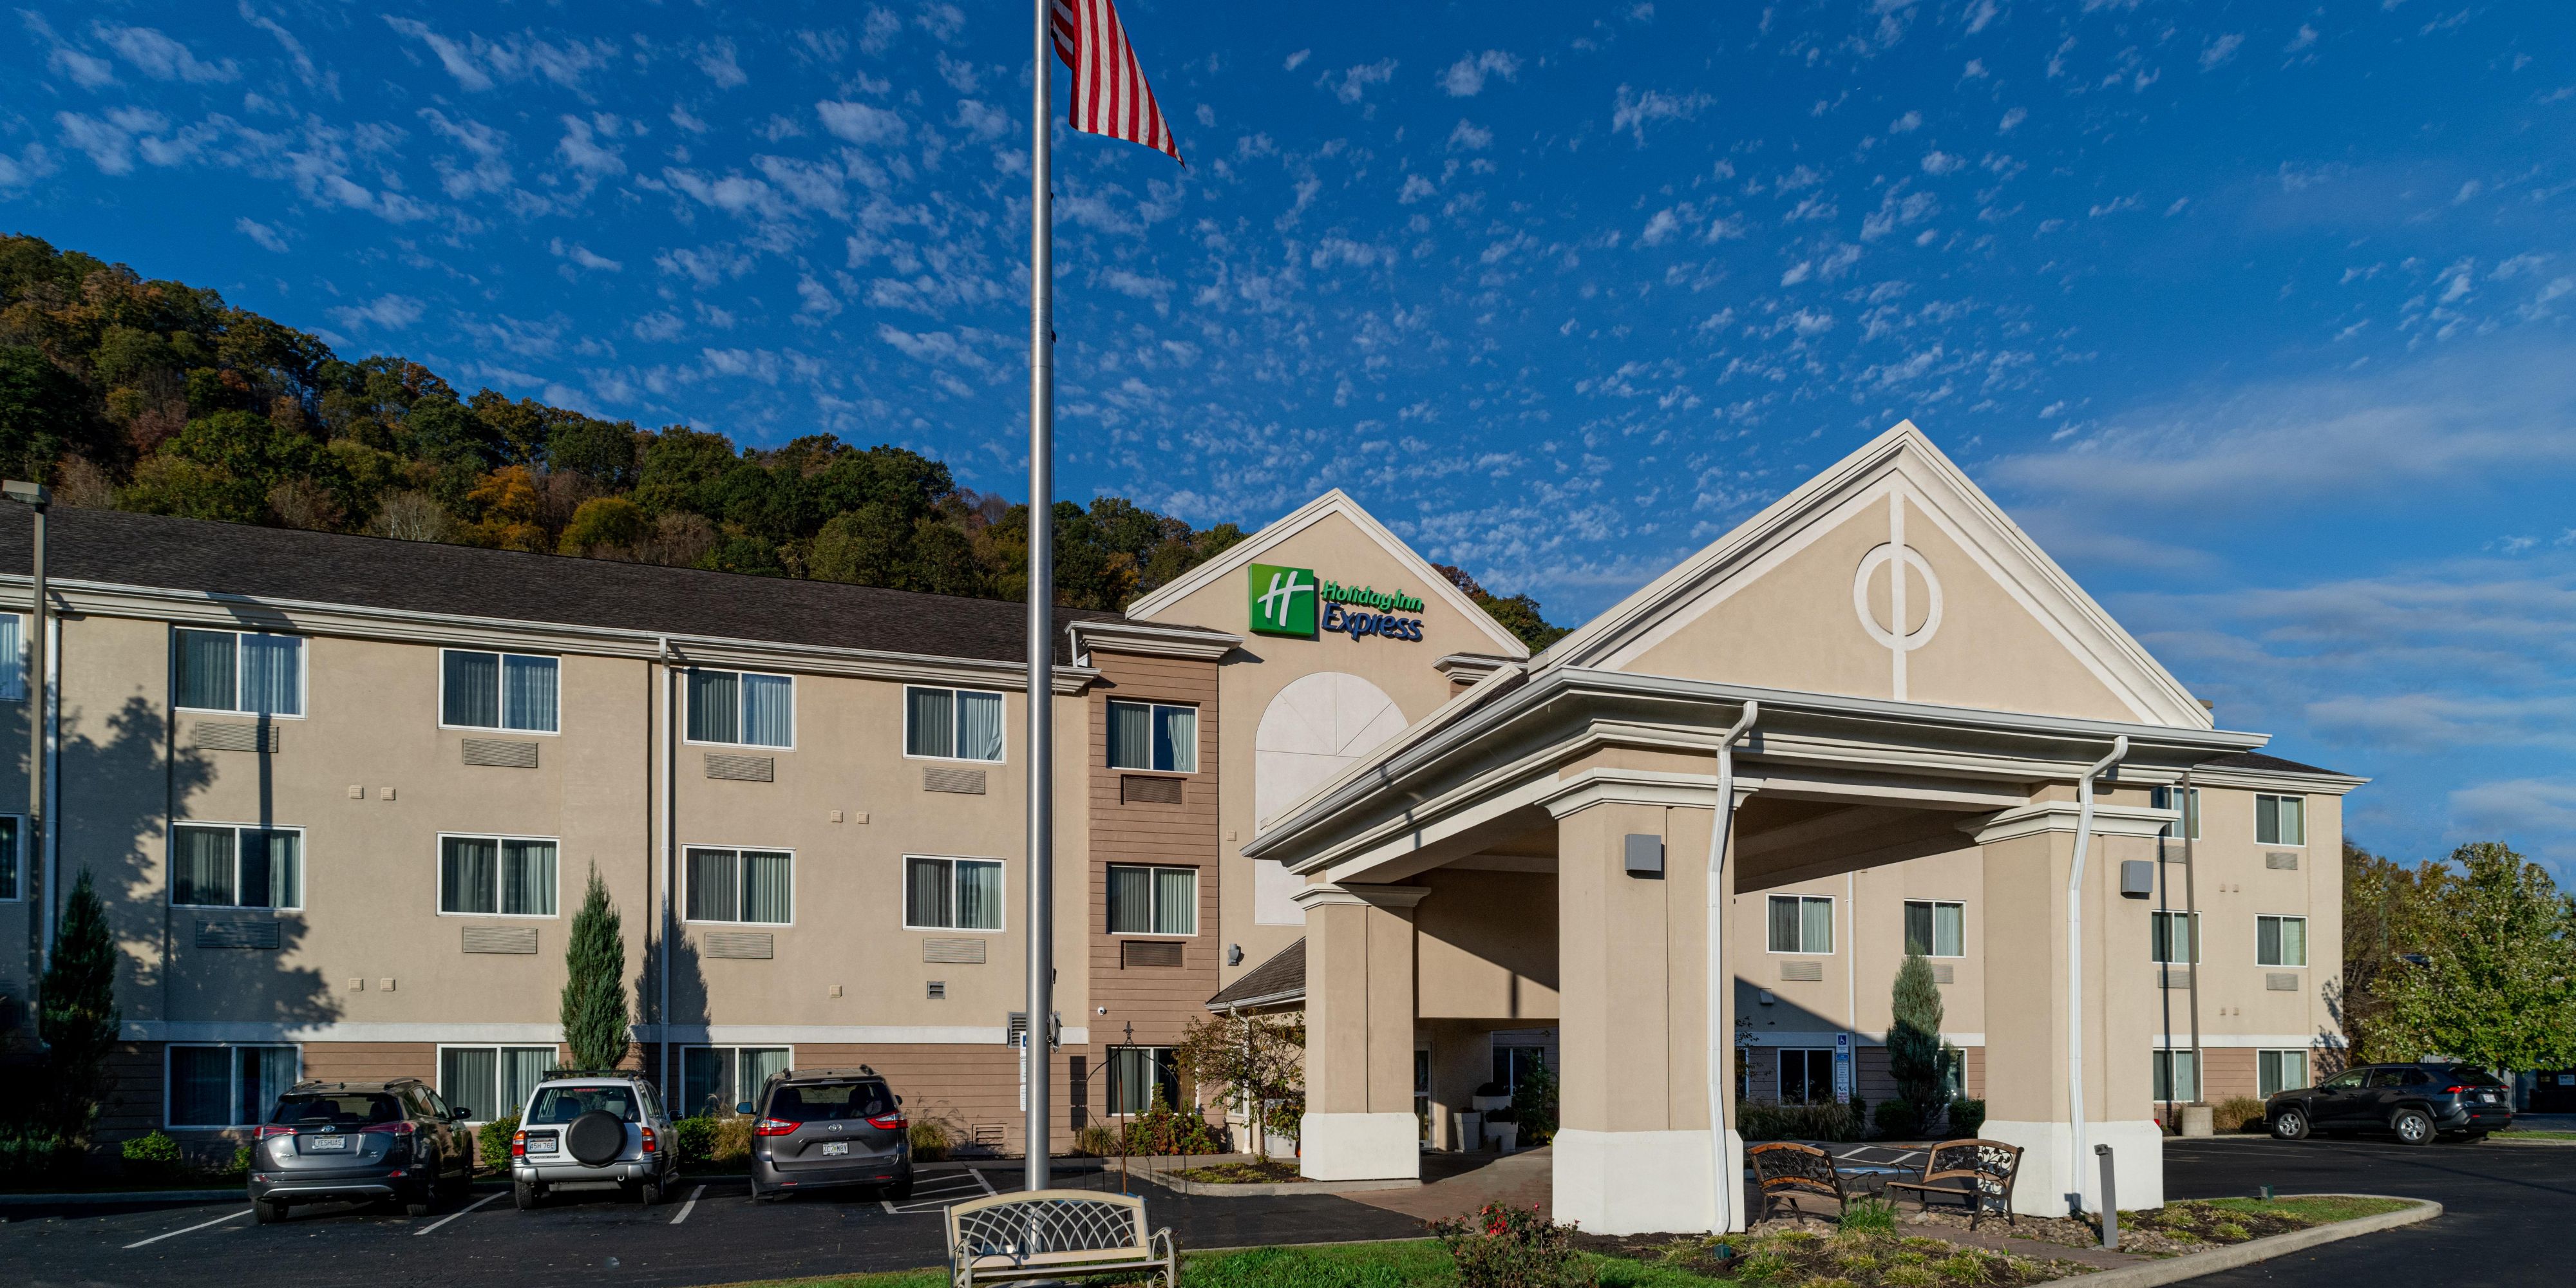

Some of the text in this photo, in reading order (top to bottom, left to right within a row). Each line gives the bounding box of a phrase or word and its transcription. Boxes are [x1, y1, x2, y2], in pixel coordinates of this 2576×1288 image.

[1321, 580, 1423, 611] Holiday Inn
[1321, 602, 1422, 640] Express
